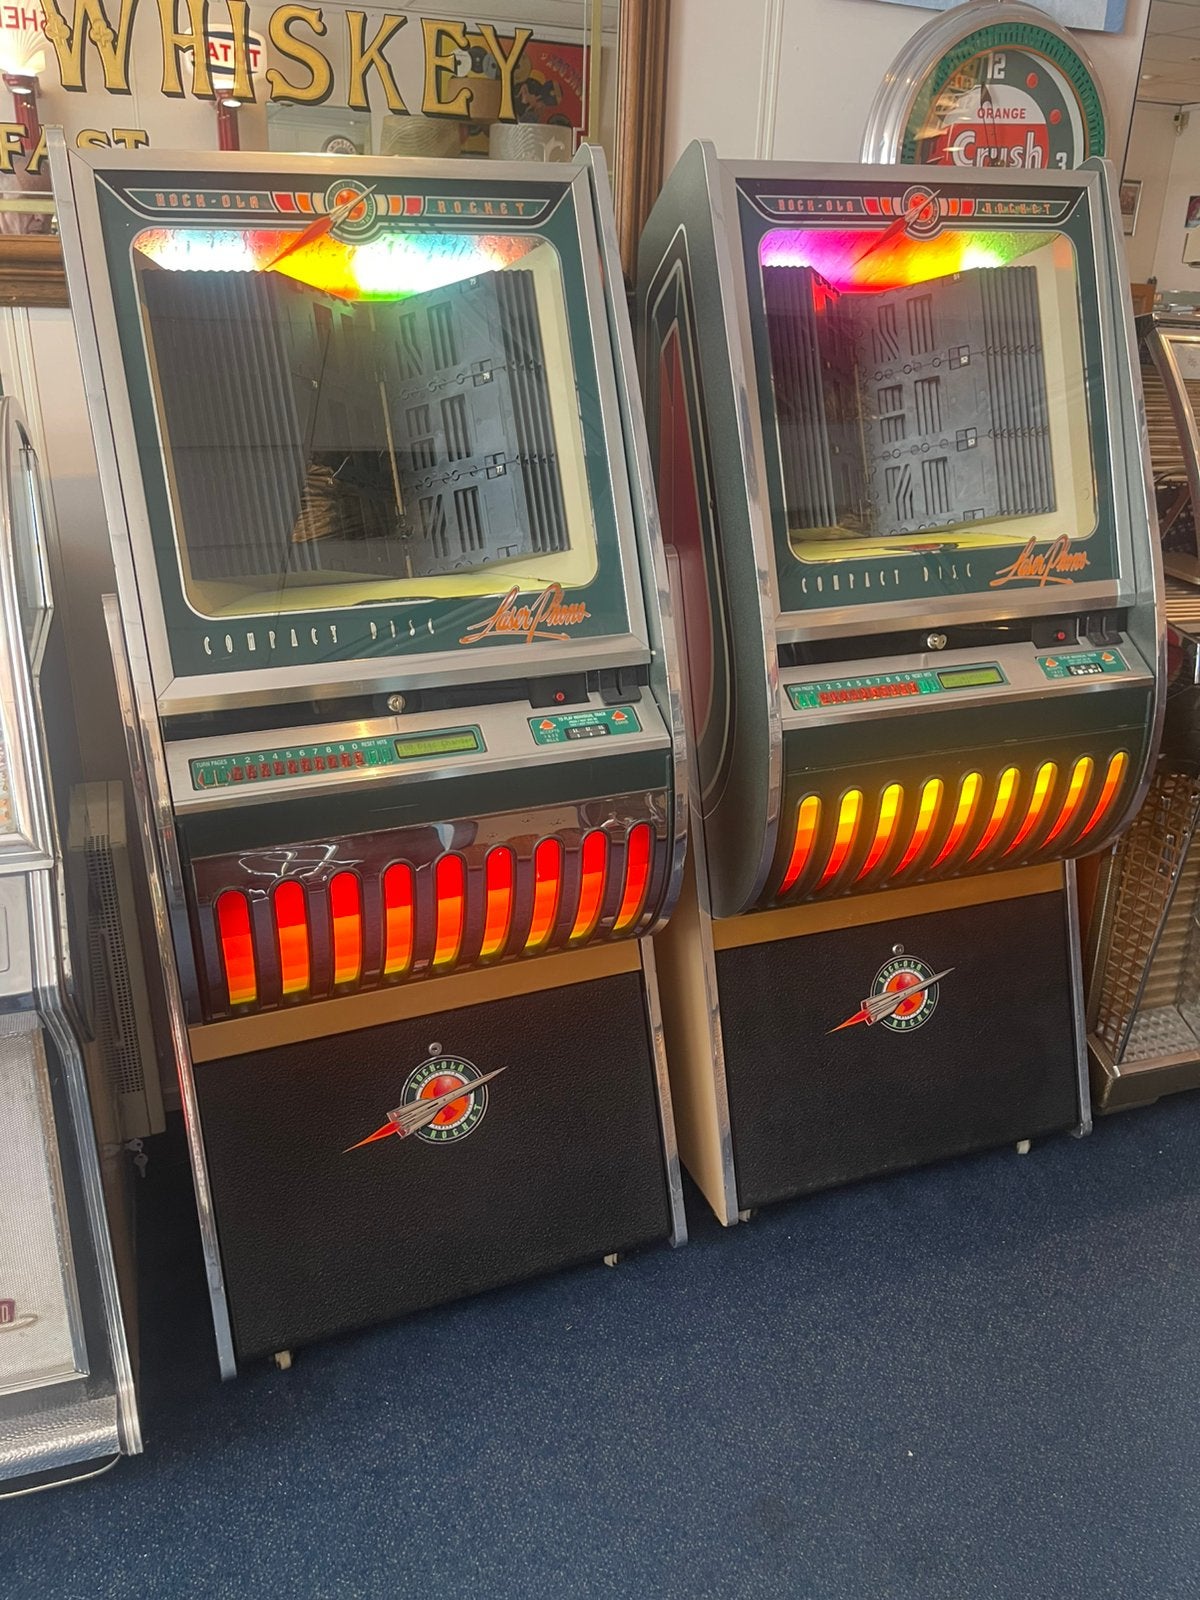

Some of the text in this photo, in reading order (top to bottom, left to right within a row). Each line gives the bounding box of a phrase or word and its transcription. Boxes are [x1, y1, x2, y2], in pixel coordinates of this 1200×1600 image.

[38, 0, 534, 124] WHISKEY
[986, 53, 1006, 79] 12
[977, 107, 1027, 120] ORANGE
[952, 129, 1043, 169] Crush
[437, 199, 525, 216] ROCKET
[801, 563, 972, 594] COMPACT DISC
[203, 617, 435, 656] COMPACT DISC
[232, 743, 359, 766] 1 2 3 4 5 6 7 8 9 0
[892, 1000, 934, 1028] ROCKET
[410, 1061, 465, 1090] ROCK-OLA
[429, 1104, 482, 1139] ROCKET
